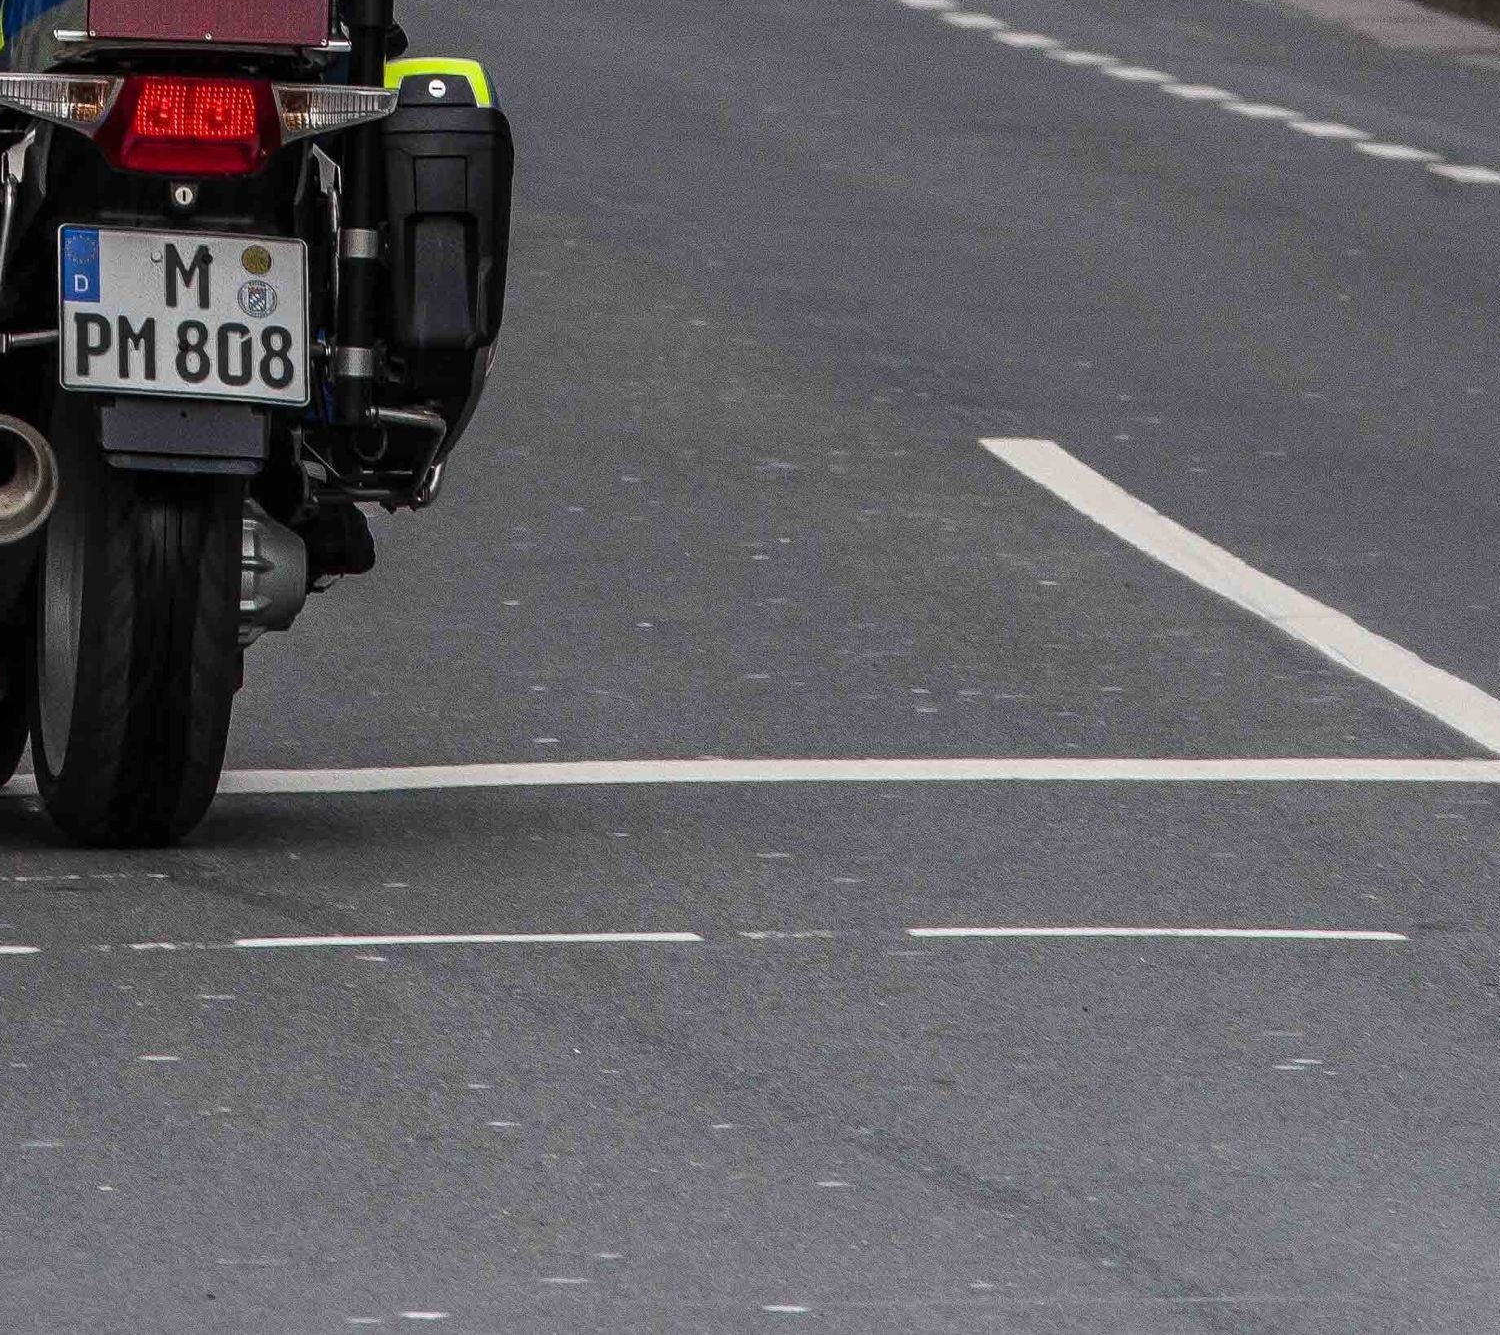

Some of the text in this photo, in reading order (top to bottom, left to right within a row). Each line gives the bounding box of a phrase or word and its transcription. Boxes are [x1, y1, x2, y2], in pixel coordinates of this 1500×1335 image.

[74, 274, 89, 293] D
[164, 243, 210, 309] M
[73, 312, 295, 390] PM 808
